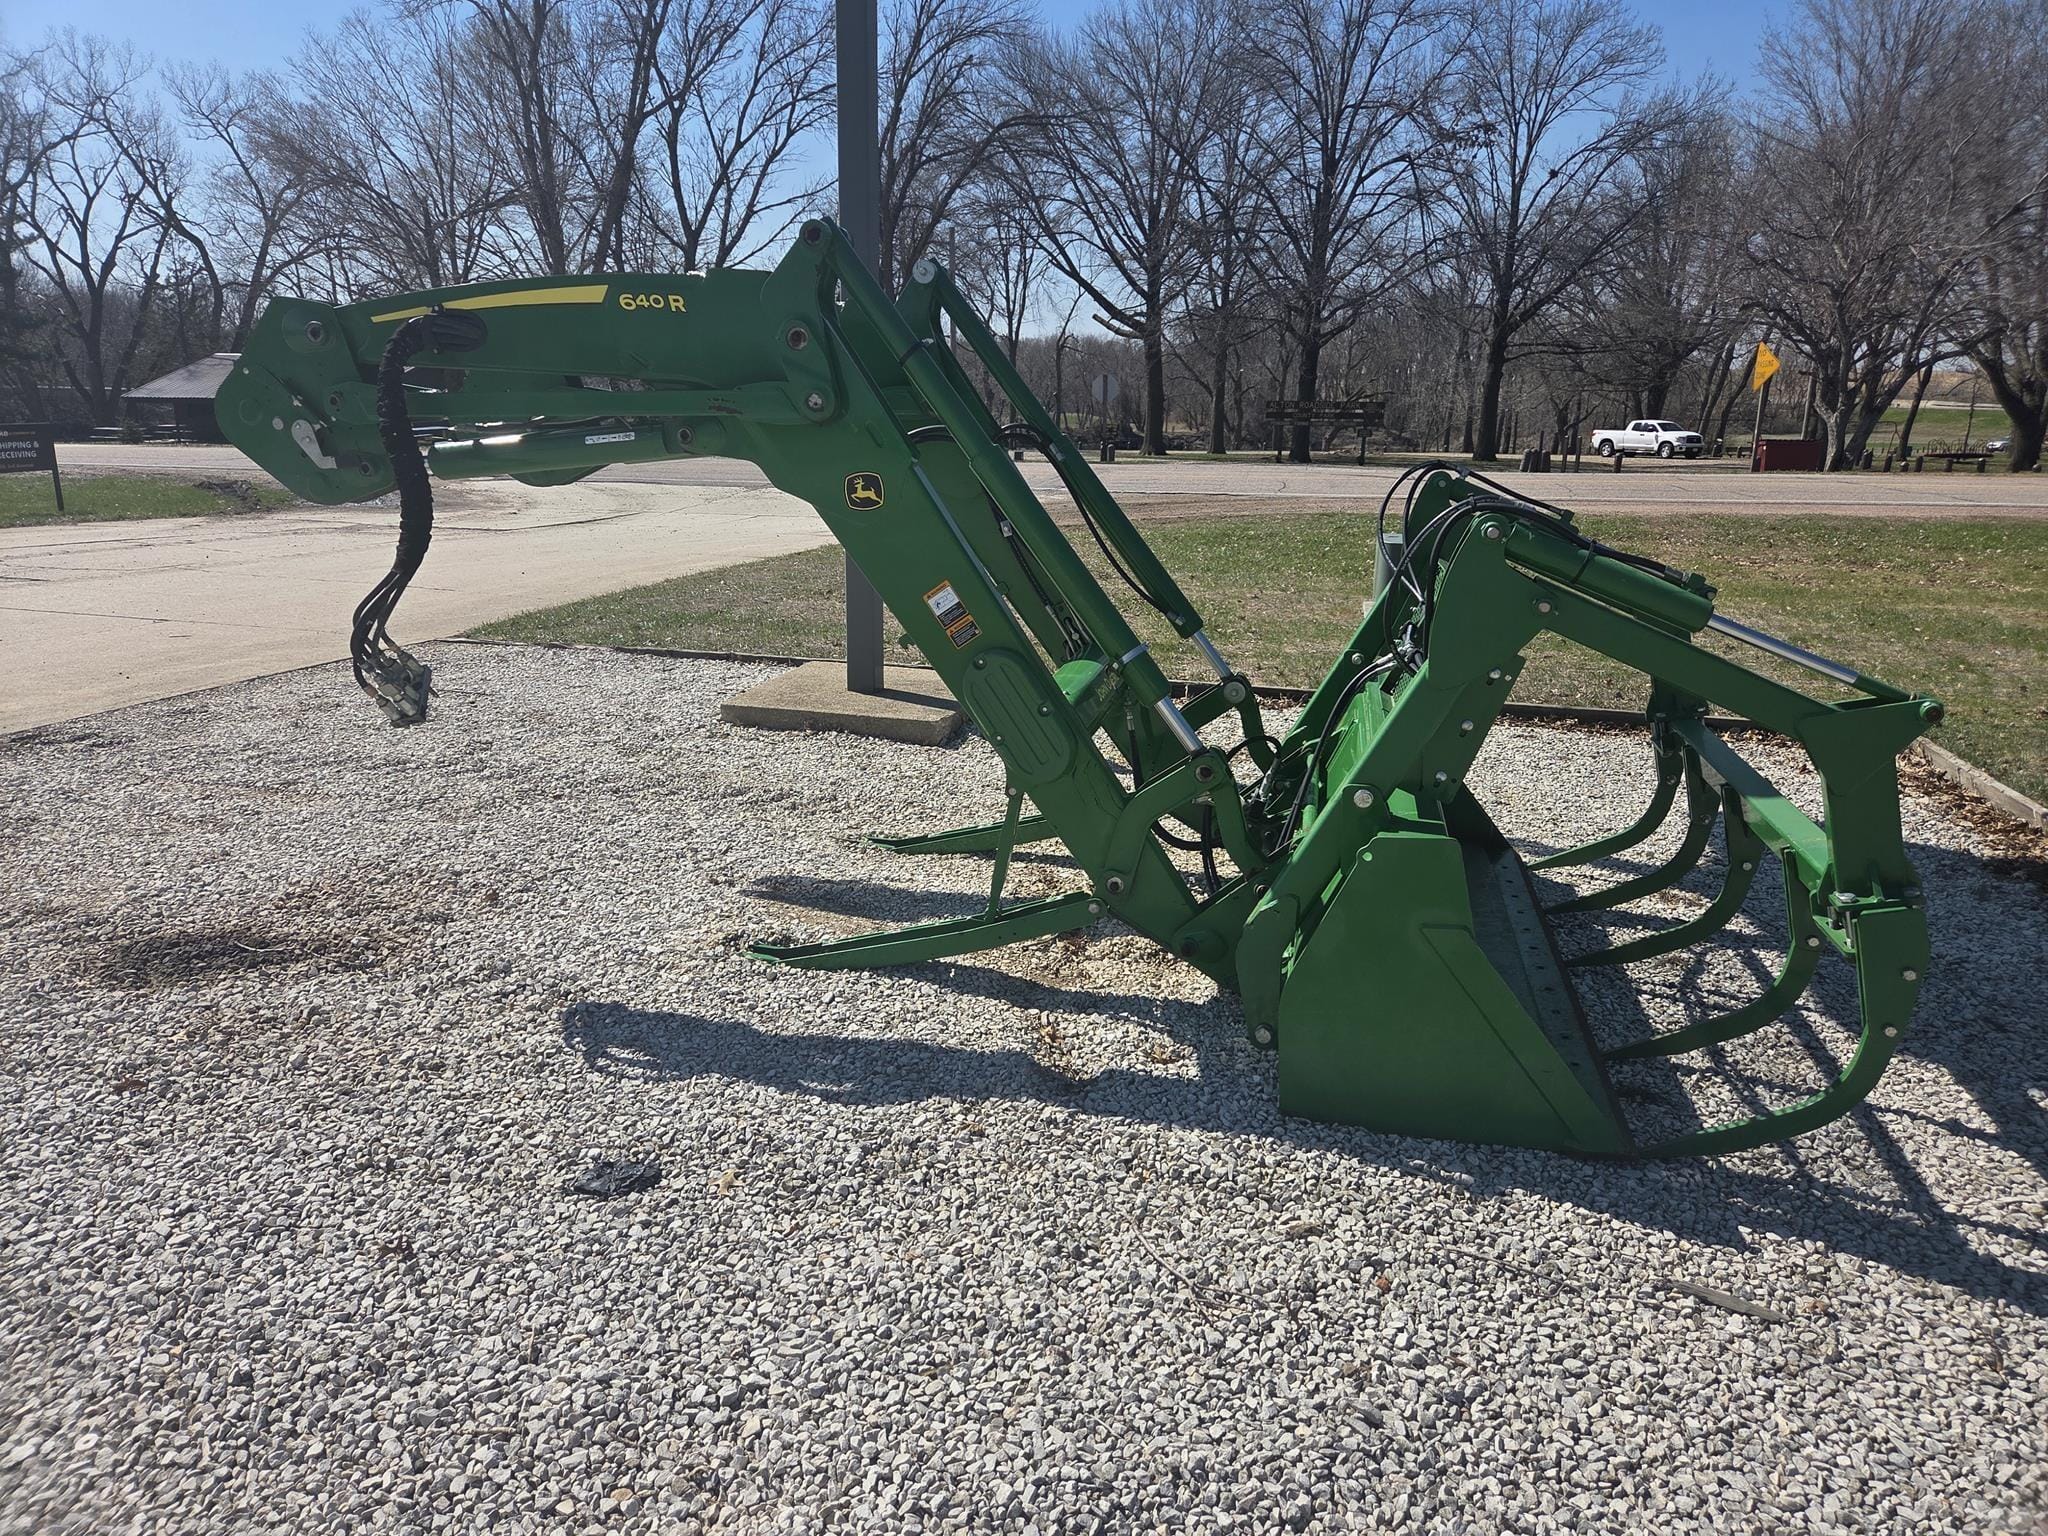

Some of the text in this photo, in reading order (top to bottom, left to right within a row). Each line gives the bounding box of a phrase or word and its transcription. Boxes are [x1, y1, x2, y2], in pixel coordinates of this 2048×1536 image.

[619, 293, 665, 311] 640
[0, 441, 32, 449] HIPPING
[0, 450, 37, 459] ECEIVING
